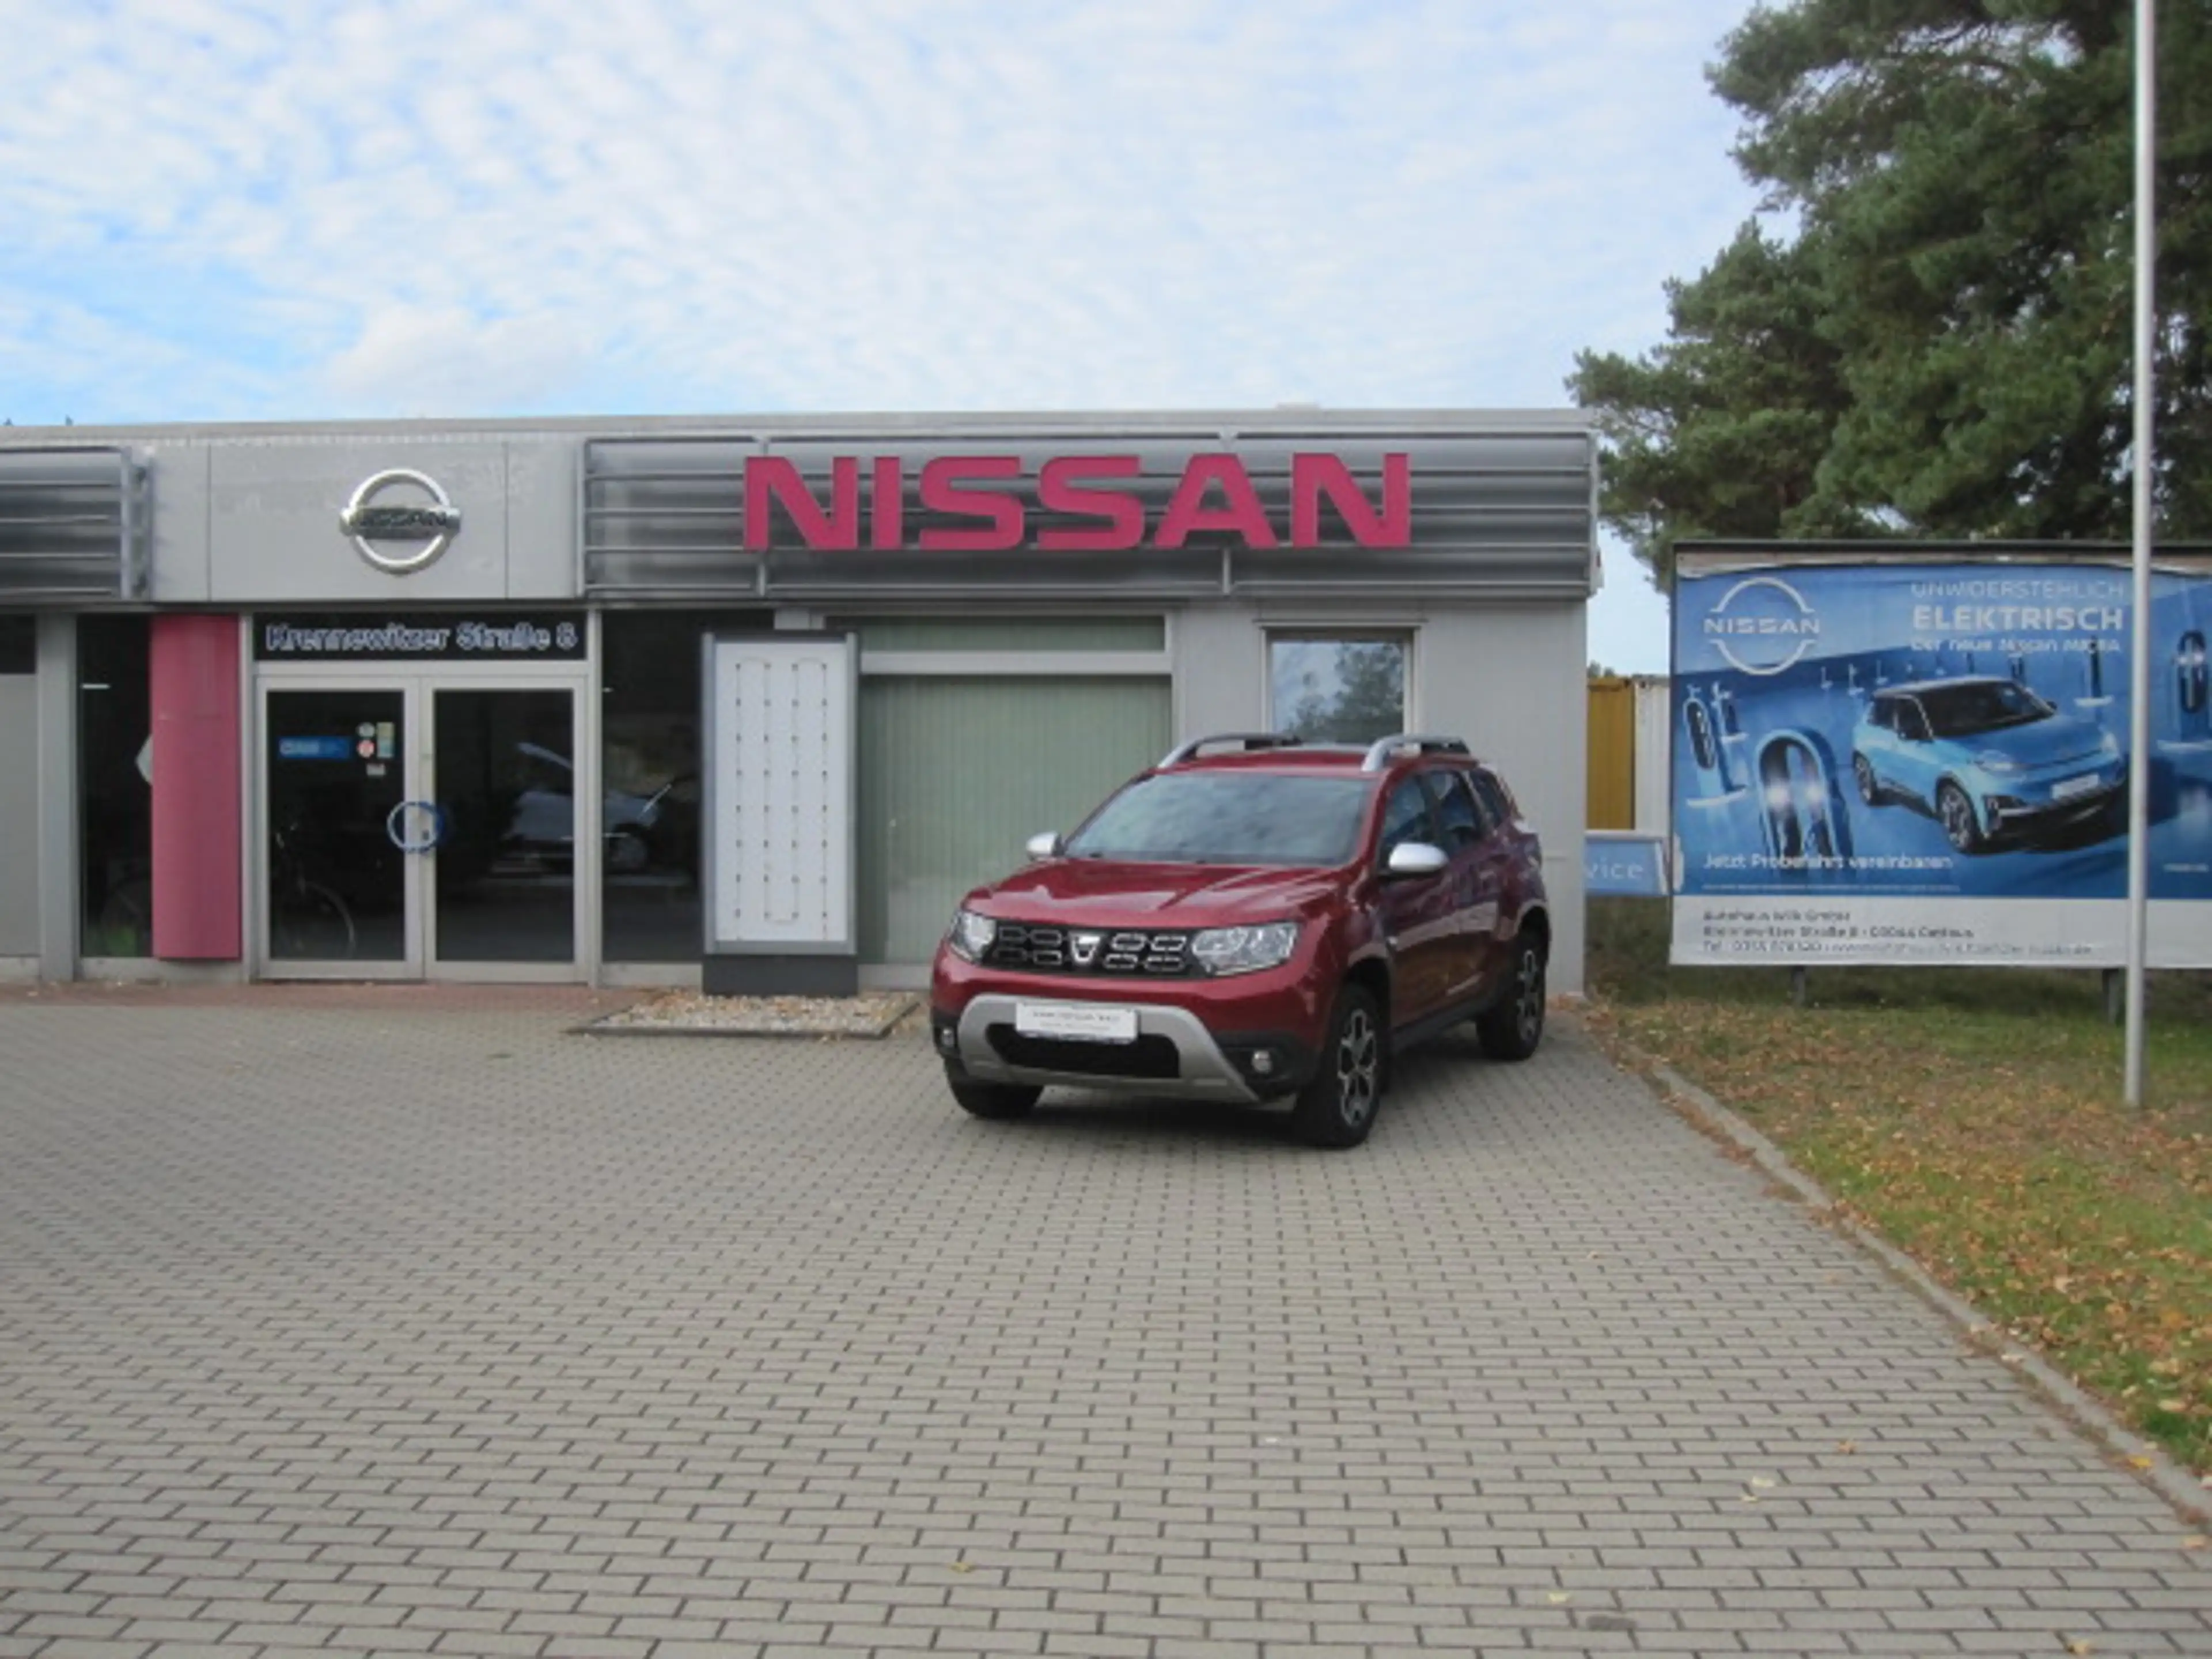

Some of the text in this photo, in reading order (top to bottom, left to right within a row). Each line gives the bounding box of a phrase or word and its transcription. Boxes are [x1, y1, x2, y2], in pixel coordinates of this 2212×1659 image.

[743, 453, 1410, 551] NISSAN
[1703, 618, 1820, 634] NISSAN
[1913, 605, 2123, 630] ELEKTRISCH
